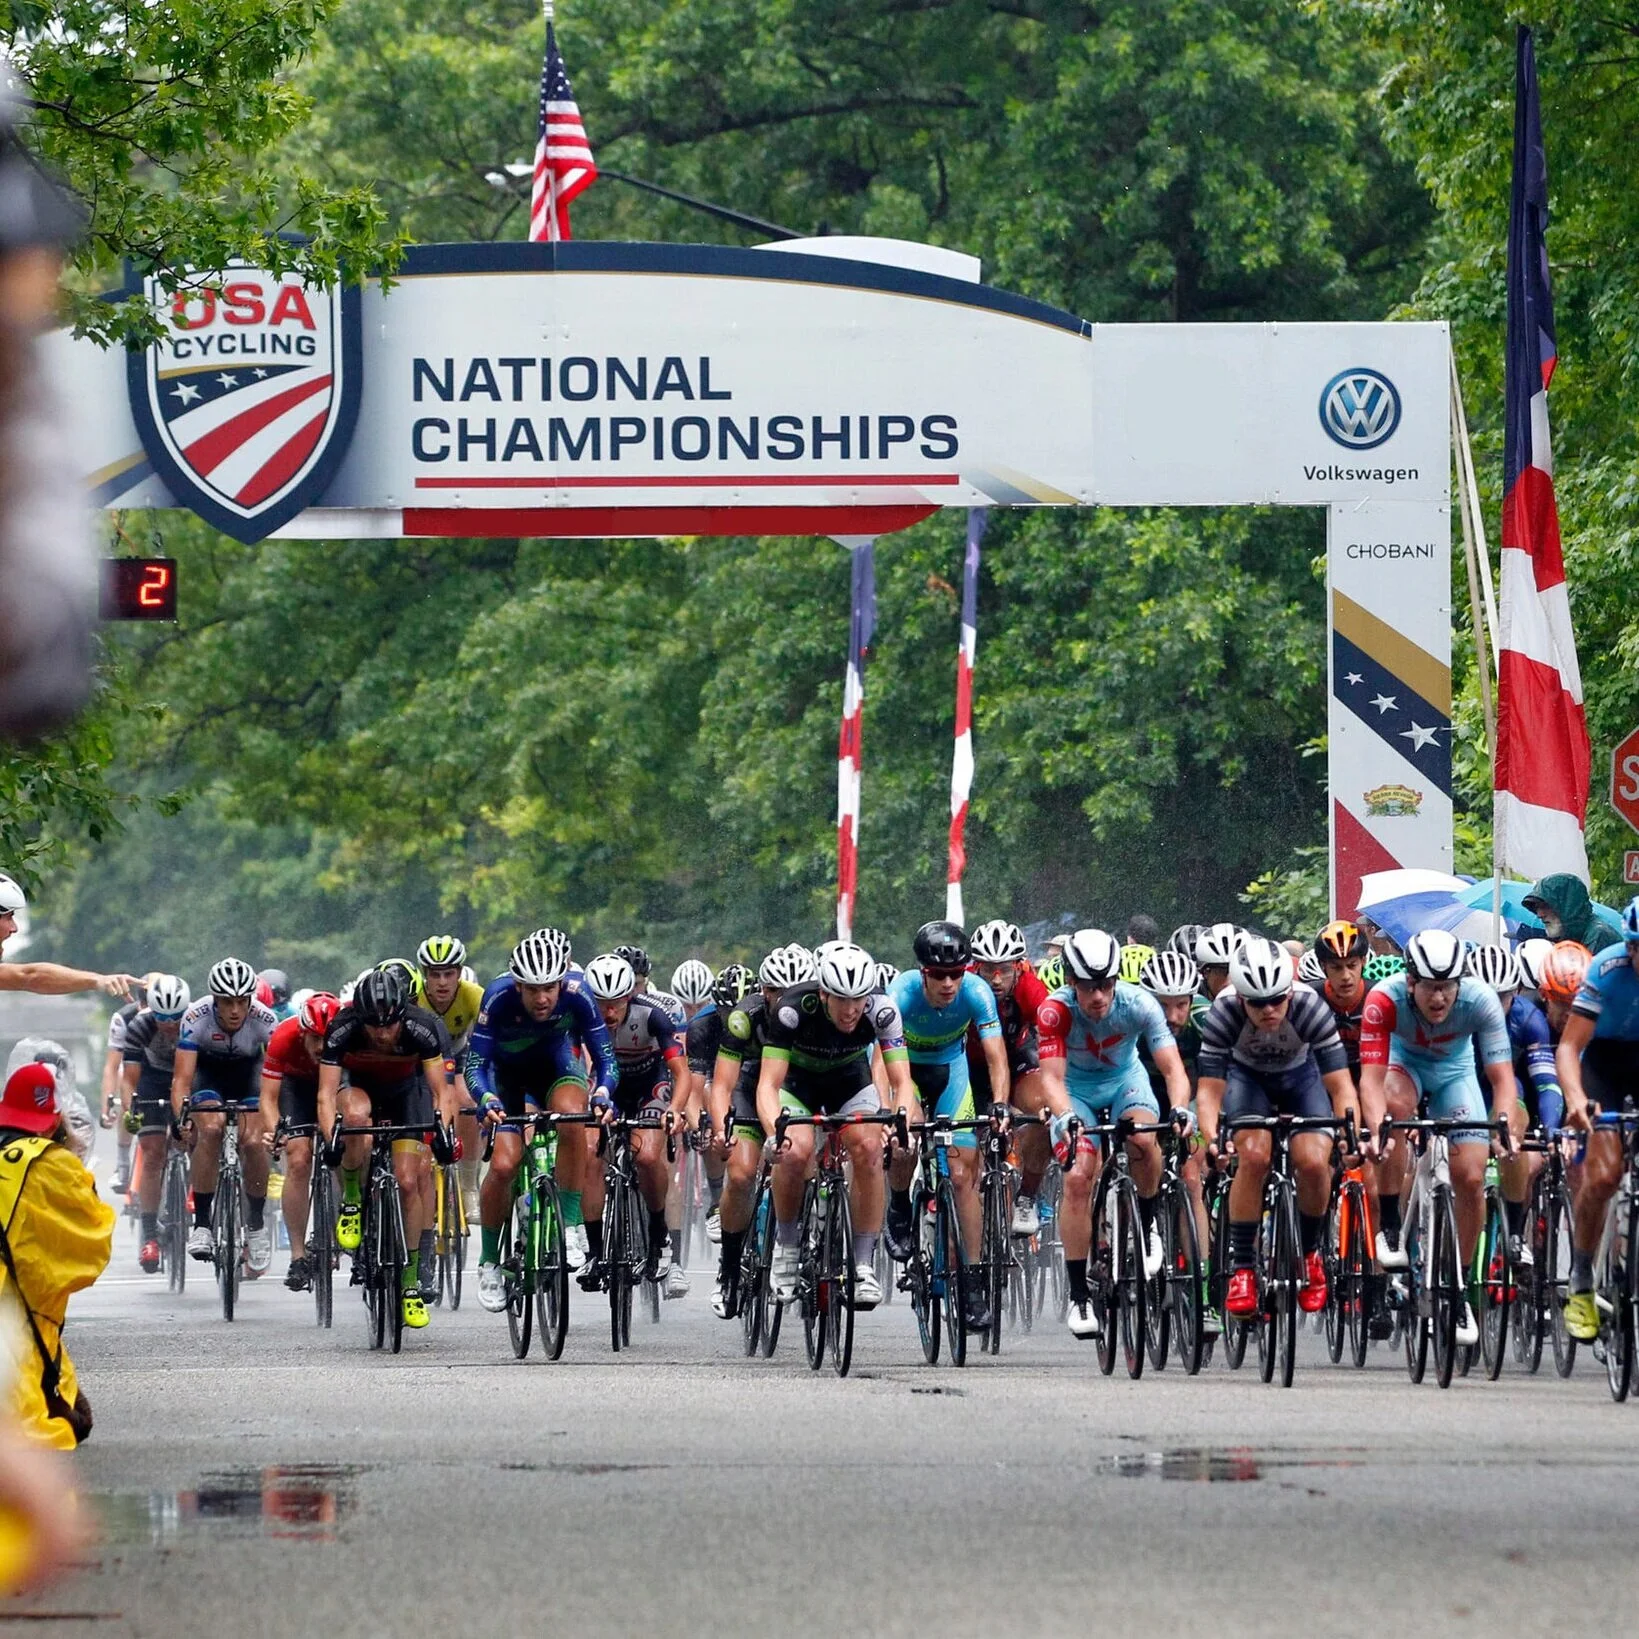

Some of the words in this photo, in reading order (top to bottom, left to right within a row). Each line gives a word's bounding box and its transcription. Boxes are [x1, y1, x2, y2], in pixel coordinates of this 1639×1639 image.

[171, 281, 317, 331] USA
[172, 333, 317, 359] CYCLING
[412, 356, 732, 402] NATIONAL
[411, 414, 960, 462] CHAMPIONSHIPS
[1303, 465, 1419, 484] Volkswagen
[1346, 543, 1434, 559] CHOBANI
[139, 566, 170, 606] 2
